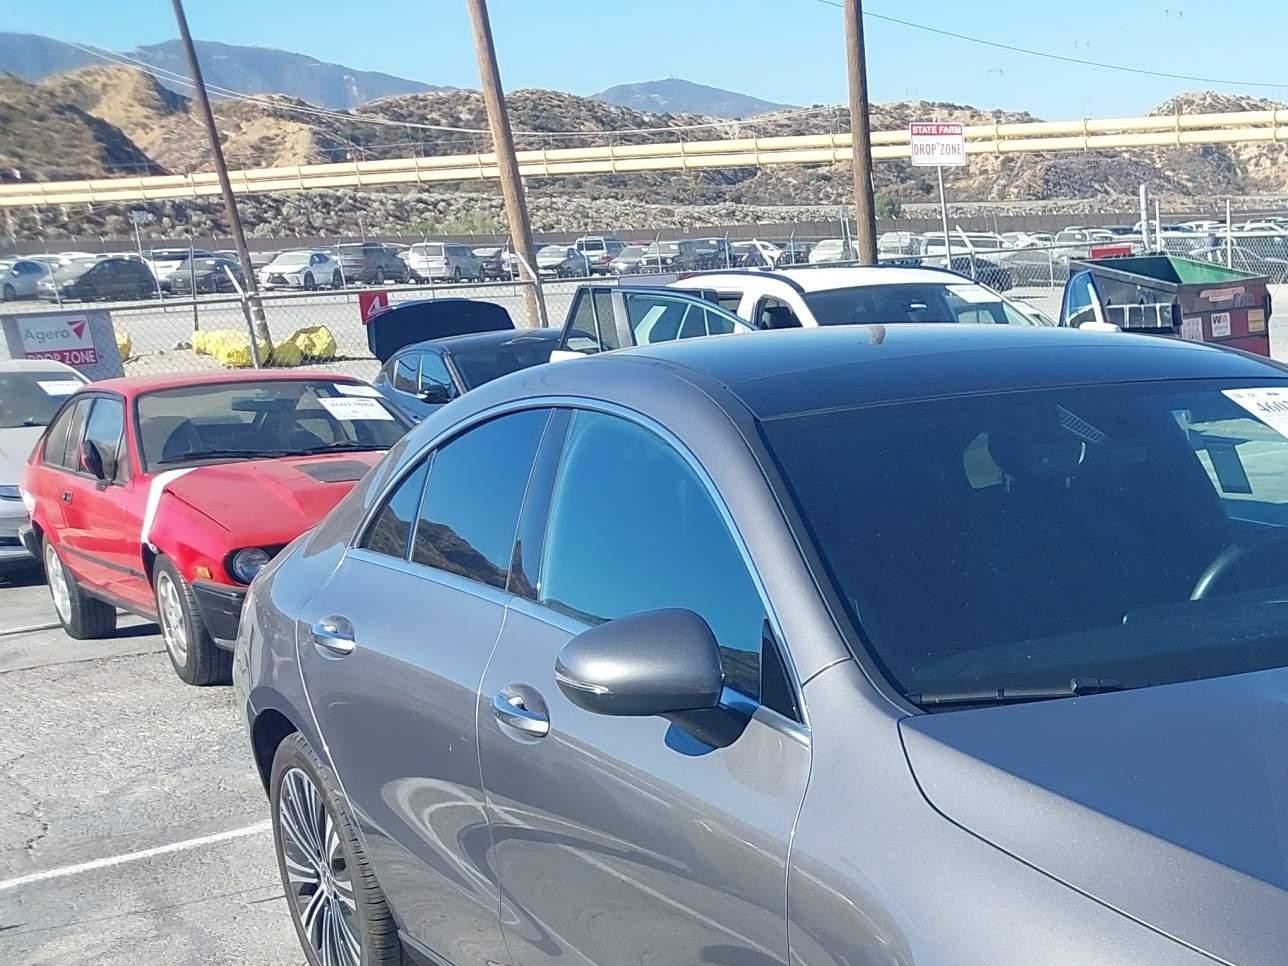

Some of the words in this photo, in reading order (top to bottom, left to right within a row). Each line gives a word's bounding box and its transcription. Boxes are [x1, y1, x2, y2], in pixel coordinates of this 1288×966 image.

[912, 125, 938, 134] STATE
[939, 125, 962, 134] FARM
[913, 143, 937, 156] DROP
[940, 143, 962, 156] ZONE
[24, 328, 70, 344] Agero
[63, 350, 96, 364] ZONE
